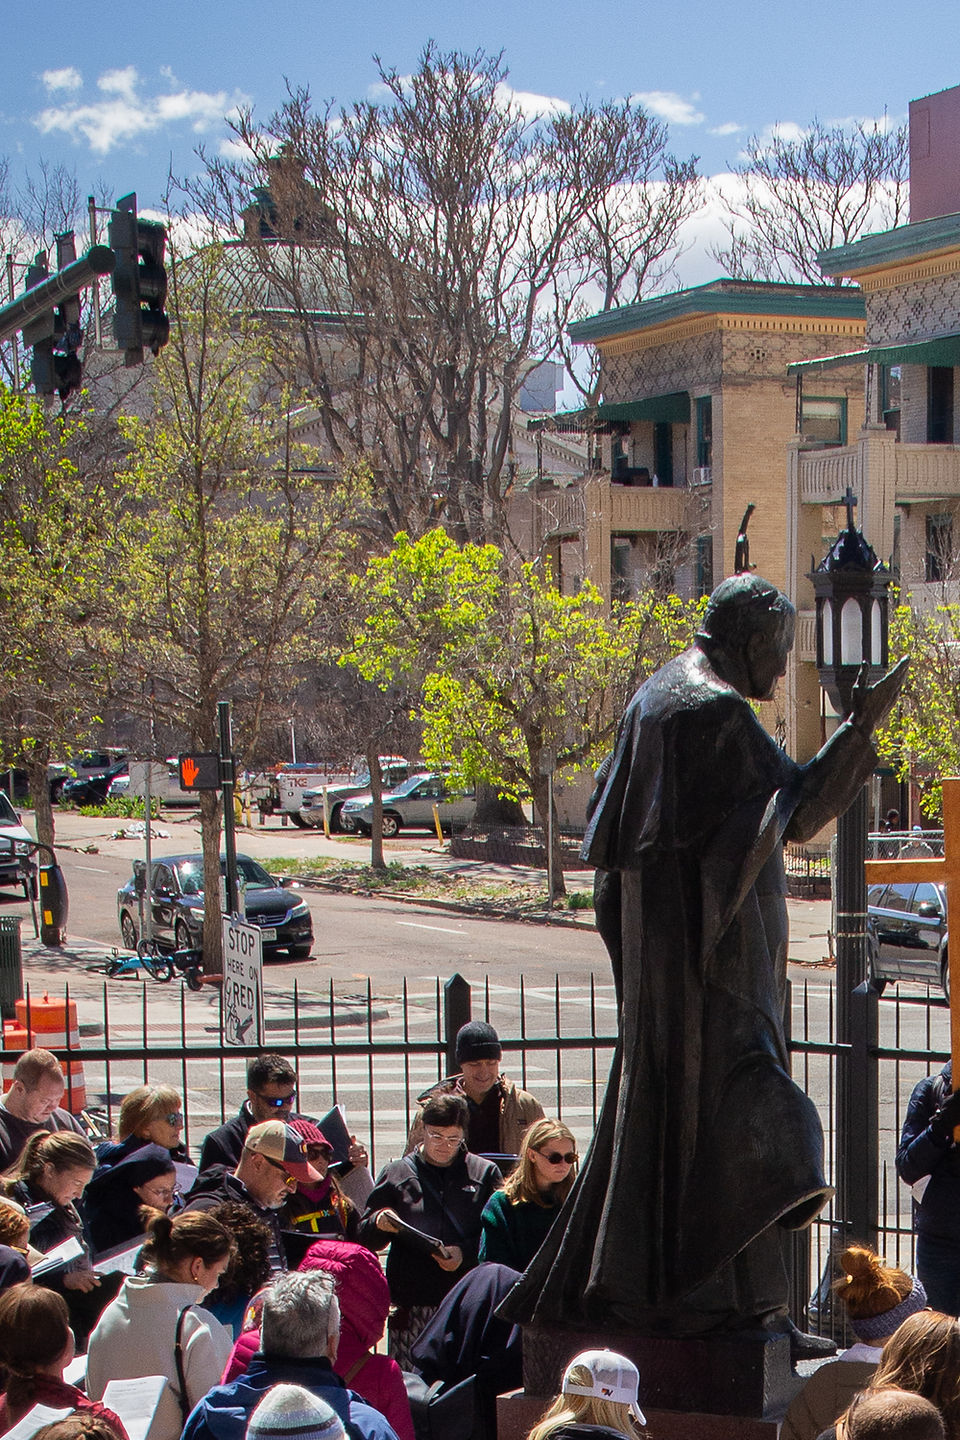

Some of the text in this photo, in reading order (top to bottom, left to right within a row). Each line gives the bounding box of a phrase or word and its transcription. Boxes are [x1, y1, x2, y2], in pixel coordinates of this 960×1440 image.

[228, 927, 255, 956] STOP
[227, 958, 244, 977] HERE
[233, 982, 254, 1010] RED
